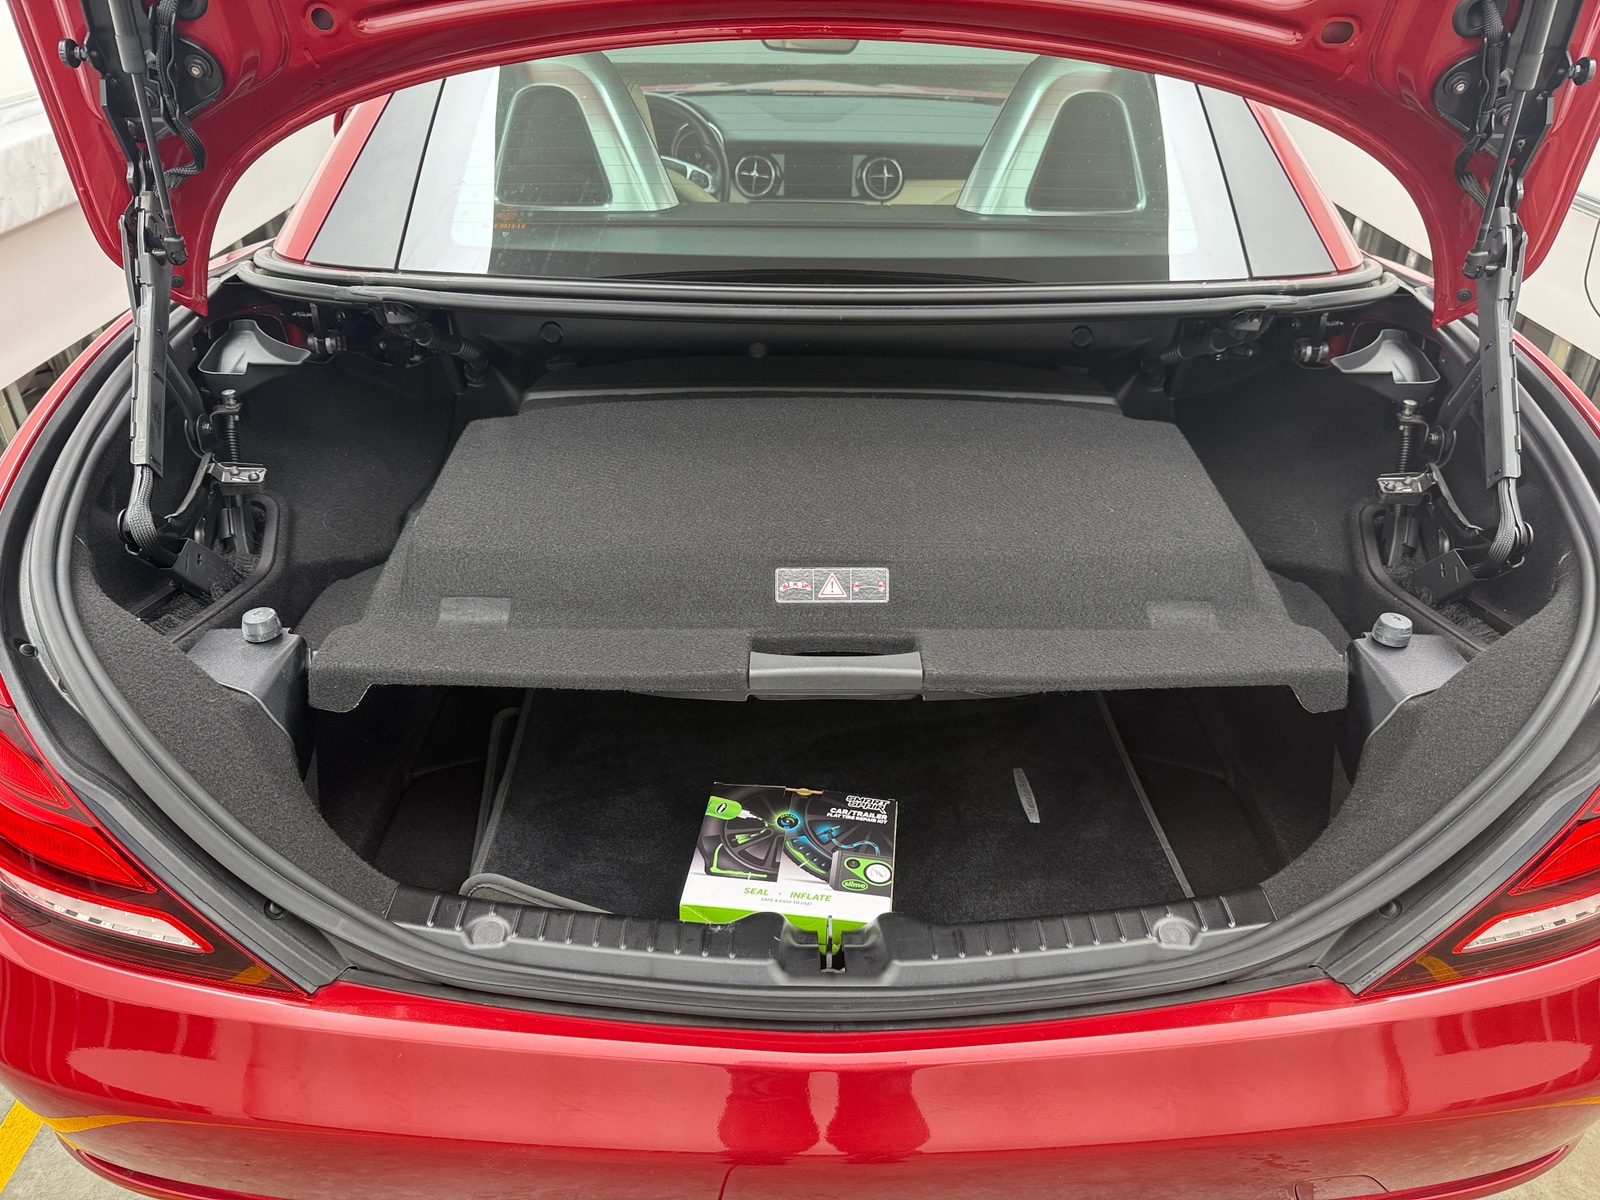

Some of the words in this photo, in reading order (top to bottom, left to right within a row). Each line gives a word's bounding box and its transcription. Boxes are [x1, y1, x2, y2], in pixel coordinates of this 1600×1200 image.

[845, 795, 890, 804] SMART
[829, 807, 888, 820] CAR/TRAILER
[743, 887, 769, 896] SEAL
[790, 891, 832, 902] INFLATE
